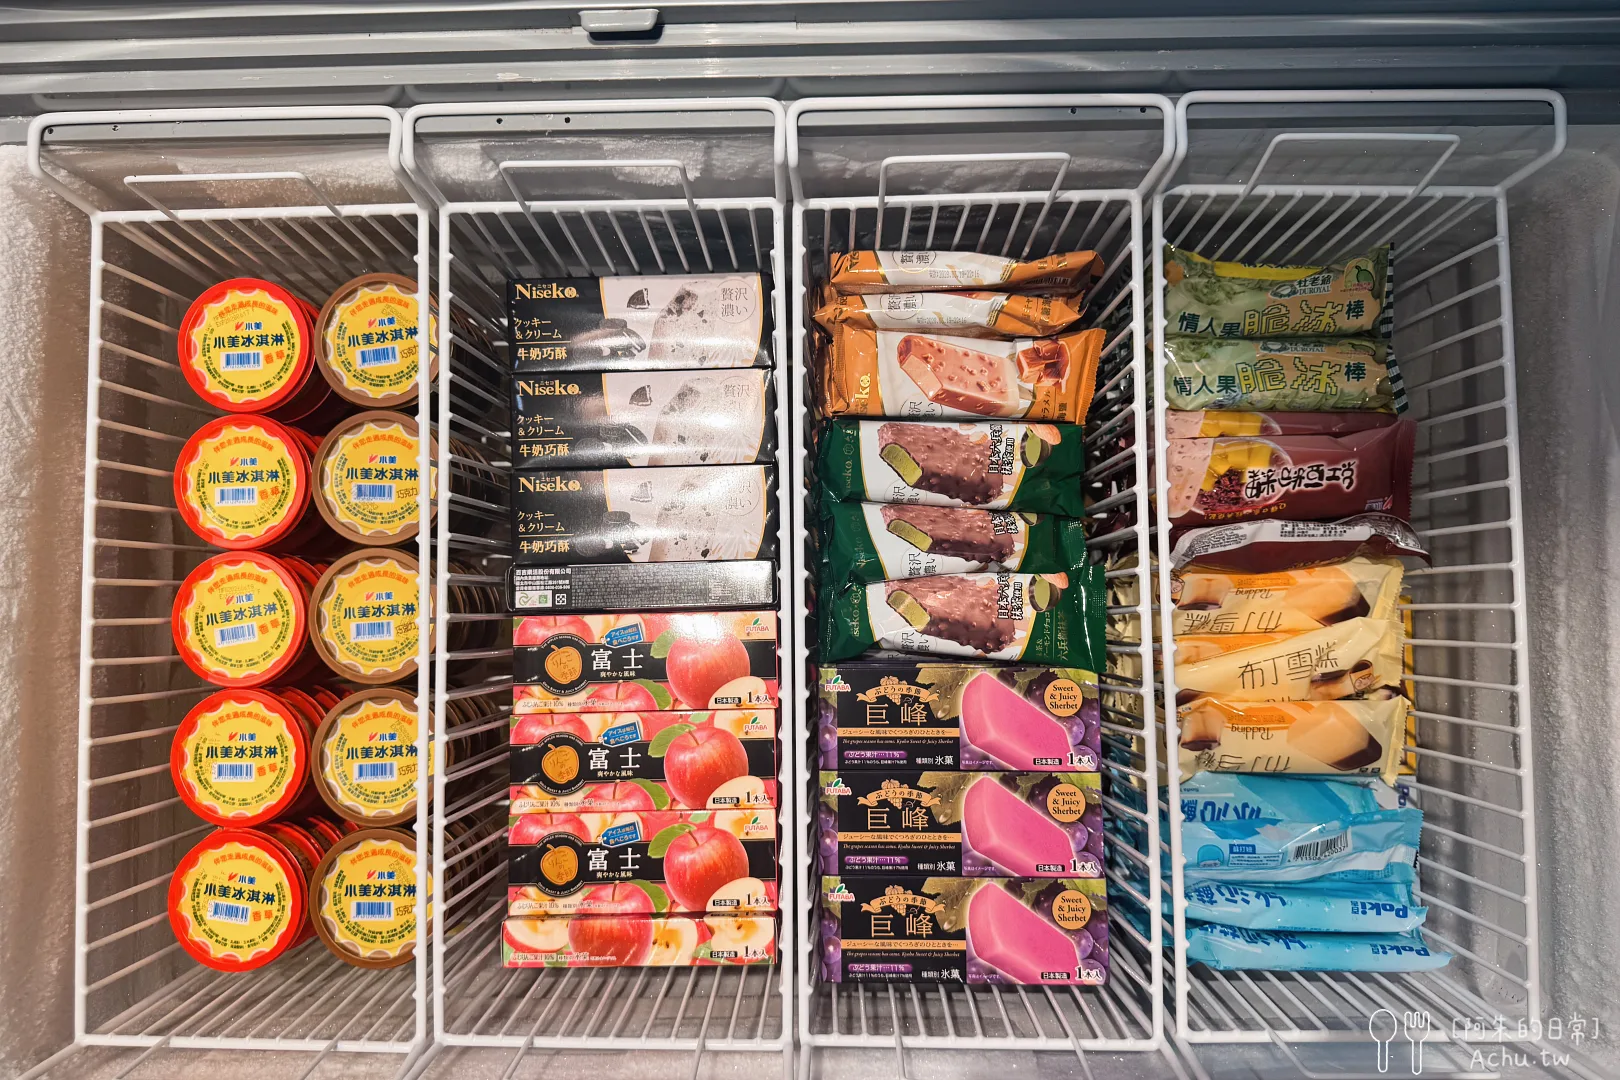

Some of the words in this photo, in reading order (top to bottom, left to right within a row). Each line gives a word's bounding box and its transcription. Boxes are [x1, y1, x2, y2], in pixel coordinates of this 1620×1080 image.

[1296, 274, 1332, 288] 杜老爺
[514, 283, 580, 300] Niseko
[721, 287, 748, 301] 贅沢
[1299, 286, 1331, 295] DUROYAL
[721, 303, 748, 317] 濃い
[378, 316, 396, 327] 小美
[514, 317, 552, 329] クッキー
[1178, 299, 1365, 338] 情人果脆冰棒
[245, 321, 263, 331] 小美
[347, 328, 418, 347] 小美冰淇淋
[515, 328, 562, 340] &クリーム
[213, 333, 285, 349] 小美冰淇淋
[263, 349, 286, 365] 香草
[517, 347, 568, 360] 牛奶巧酥
[1173, 357, 1366, 397] 情人果脆冰棒
[517, 380, 582, 397] Niseko
[516, 414, 554, 425] クッキー
[517, 425, 565, 437] &クリーム
[519, 444, 569, 457] 牛奶巧酥
[1001, 437, 1015, 476] 抹茶使用
[240, 457, 258, 467] 小美
[378, 455, 397, 465] 小美
[208, 469, 280, 484] 小美冰淇淋
[345, 467, 418, 481] 小美冰淇淋
[1246, 460, 1358, 498] 紅豆粉粿
[518, 476, 582, 494] Niseko
[258, 486, 281, 501] 香草
[396, 487, 418, 498] 巧克力
[517, 510, 555, 521] クッキー
[518, 521, 566, 533] &クリーム
[519, 540, 570, 554] 牛奶巧酥
[235, 593, 254, 604] 小美
[375, 591, 393, 601] 小美
[1235, 587, 1273, 600] Pudding
[1010, 581, 1023, 621] 抹茶使用
[206, 602, 278, 626] 小美冰淇淋
[343, 604, 416, 619] 小美冰淇淋
[258, 618, 281, 635] 香草
[1182, 611, 1283, 634] 布丁雪糕
[591, 648, 644, 670] 富士
[1238, 640, 1339, 690] 布丁雪糕
[825, 683, 851, 692] FUTABA
[873, 685, 922, 696] ぶどうの季節
[1052, 684, 1074, 692] Sweet
[747, 692, 770, 703] 1本入
[1058, 693, 1078, 702] Juicy
[1049, 701, 1078, 710] Sherbet
[866, 703, 928, 726] 巨峰
[238, 732, 256, 742] 小美
[378, 732, 397, 742] 小美
[1231, 726, 1274, 741] Pudding
[205, 745, 278, 759] 小美冰淇淋
[346, 745, 417, 760] 小美冰淇淋
[589, 747, 642, 770] 富士
[934, 755, 954, 765] 氷菓
[1067, 753, 1093, 766] 1本入
[256, 763, 278, 777] 香草
[745, 791, 769, 803] 1本入
[825, 787, 852, 795] FUTABA
[874, 788, 924, 800] ぶどうの季節
[1055, 789, 1076, 798] Sweet
[1061, 798, 1081, 807] Juicy
[1052, 806, 1081, 815] Sherbet
[867, 807, 929, 830] 巨峰
[587, 848, 640, 871] 富士
[936, 860, 956, 871] 氷菓
[1070, 859, 1097, 872] 1本入
[1038, 864, 1063, 872] 日本製造
[237, 874, 256, 885] 小美
[377, 870, 396, 880] 小美
[203, 882, 276, 905] 小美冰淇淋
[344, 882, 416, 897] 小美冰淇淋
[745, 893, 770, 905] 1本入
[828, 893, 855, 901] FUTABA
[878, 895, 928, 906] ぶどうの季節
[1061, 895, 1082, 904] Sweet
[252, 908, 274, 922] 香草
[1058, 904, 1065, 912] &
[1067, 904, 1086, 913] Juicy
[1360, 902, 1409, 919] Poki
[1057, 913, 1087, 923] Sherbet
[870, 913, 934, 938] 巨峰
[742, 945, 767, 958] 1本入
[1381, 946, 1430, 957] Poki
[921, 970, 939, 978] 種類別
[940, 968, 960, 979] 氷菓
[1075, 966, 1102, 980] 1本入
